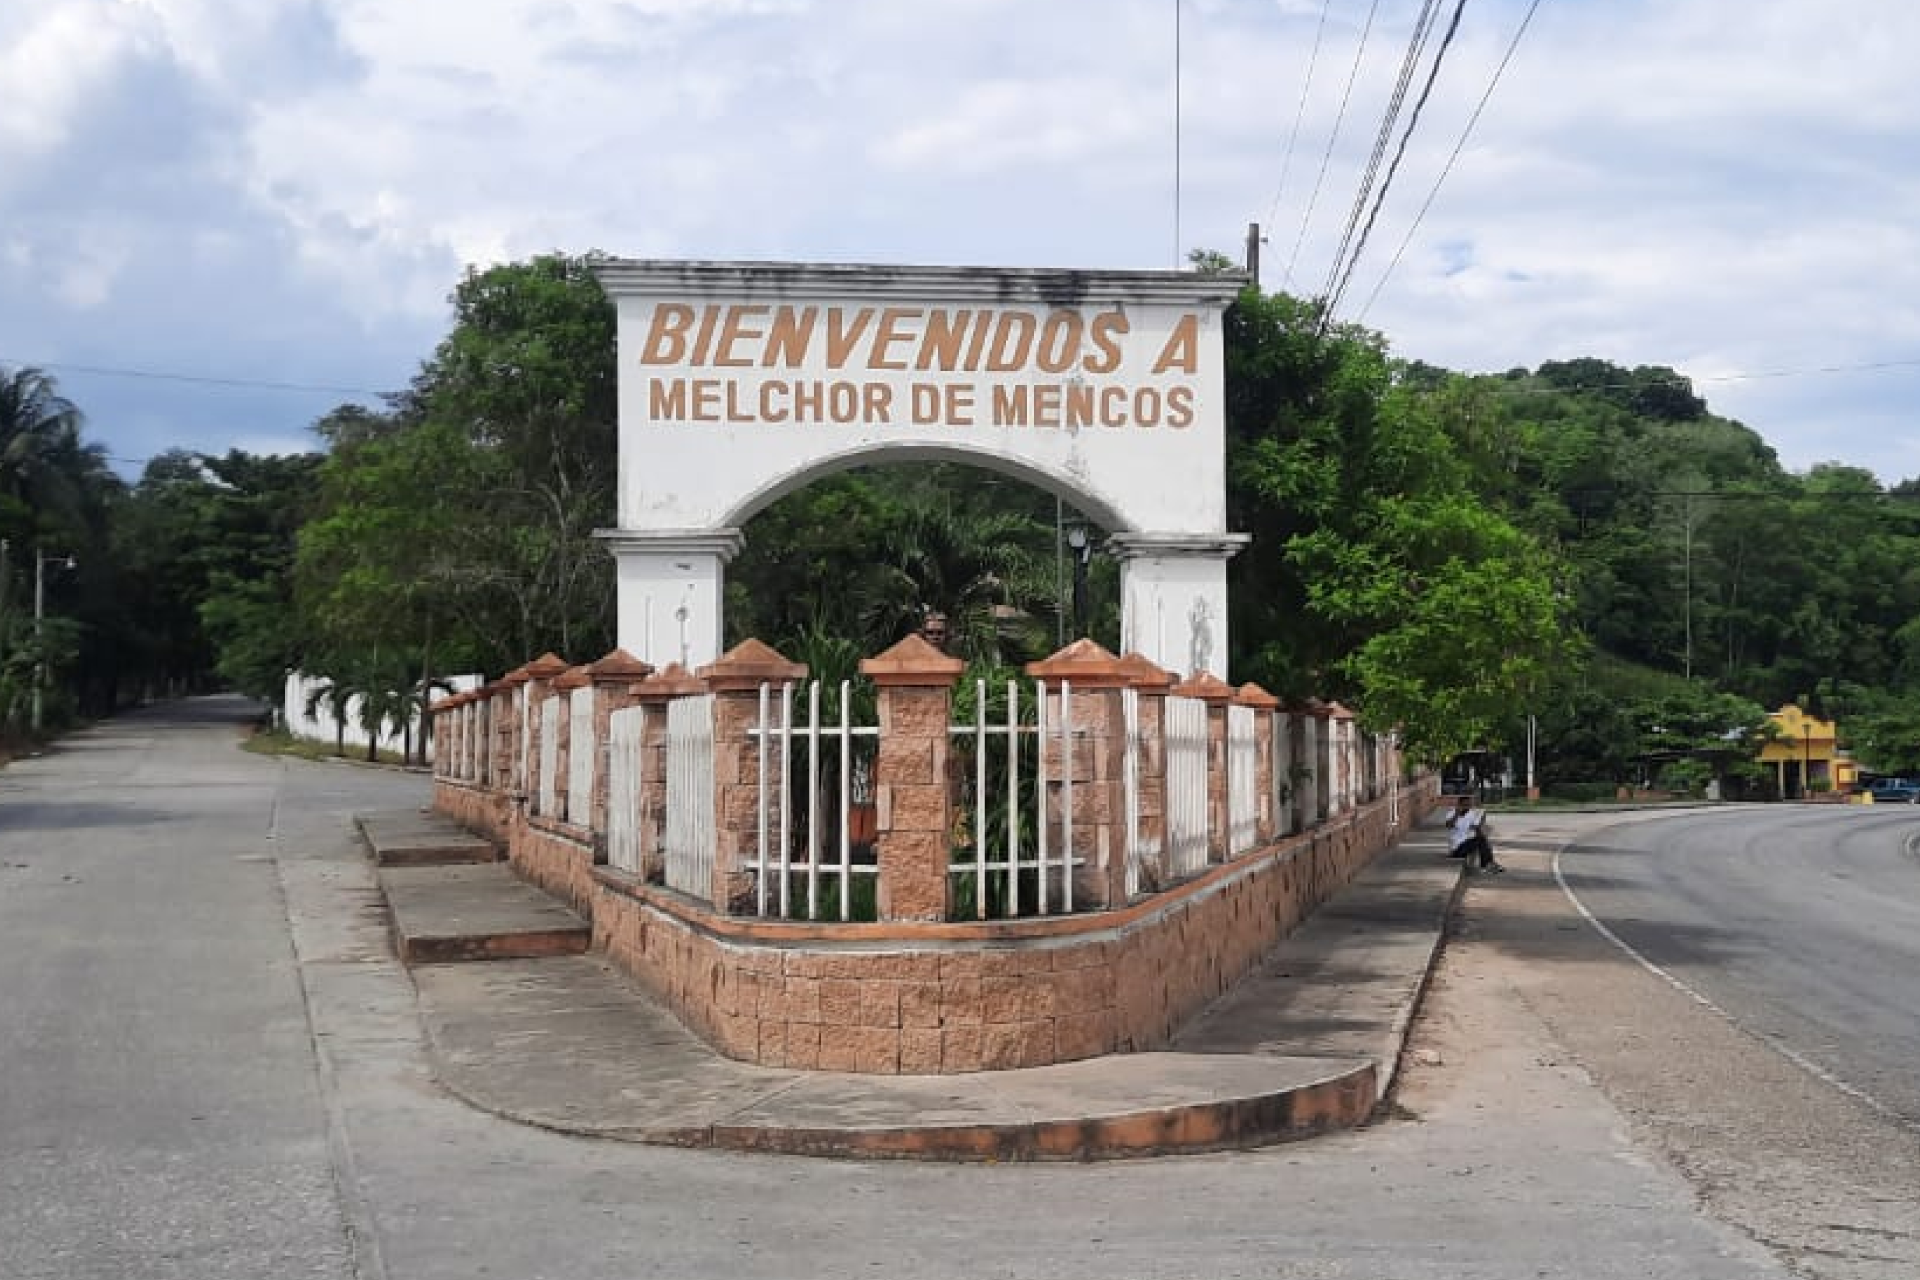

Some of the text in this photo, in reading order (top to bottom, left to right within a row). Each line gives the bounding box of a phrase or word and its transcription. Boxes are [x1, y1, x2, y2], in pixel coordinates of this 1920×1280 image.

[640, 302, 1198, 375] BIENVENIDOS A
[649, 379, 1194, 428] MELCHOR DE MENCOS
